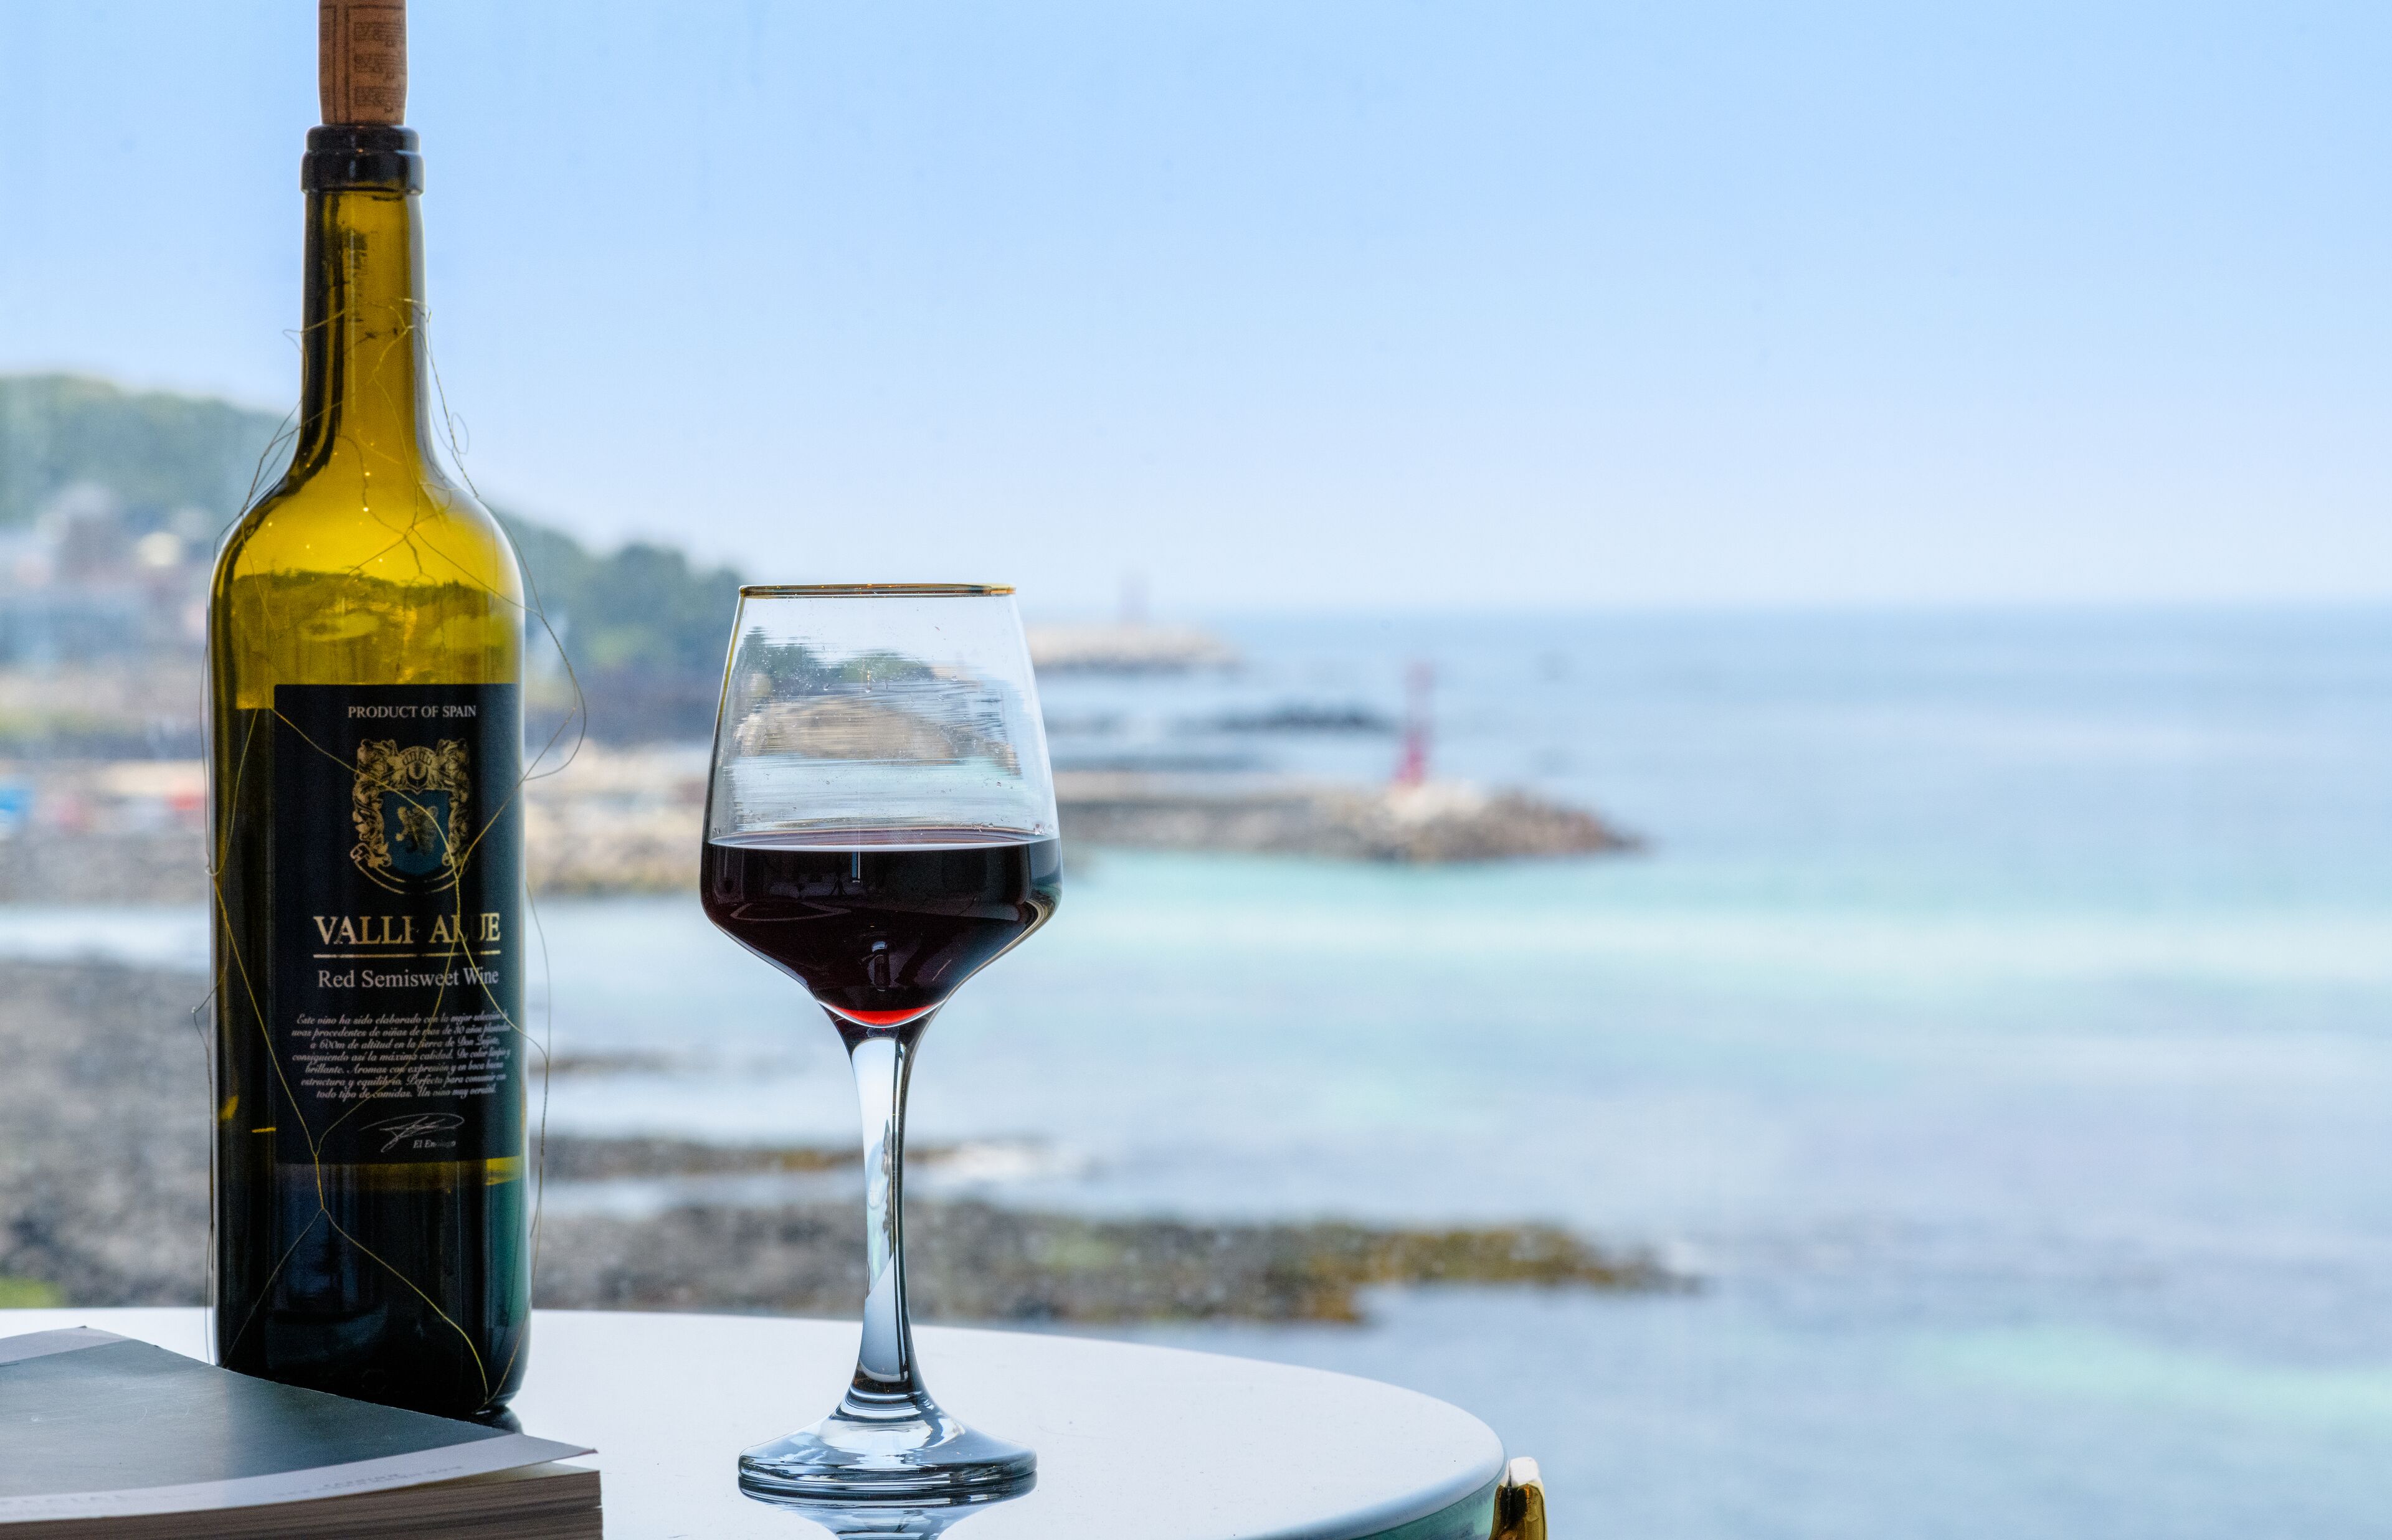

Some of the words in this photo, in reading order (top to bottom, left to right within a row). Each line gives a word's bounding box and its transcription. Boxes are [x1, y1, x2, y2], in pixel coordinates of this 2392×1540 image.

[348, 706, 418, 718] PRODUCT
[421, 706, 439, 717] OF
[442, 705, 477, 717] SPAIN
[318, 970, 355, 988] Red
[361, 969, 459, 988] Semisweet
[463, 966, 498, 985] Wine
[339, 1014, 351, 1024] ha
[353, 1014, 373, 1024] sido
[375, 1013, 422, 1024] elaborado
[311, 1026, 368, 1041] procedentes
[369, 1026, 381, 1036] de
[409, 1026, 420, 1036] de
[442, 1024, 452, 1034] de
[319, 1038, 345, 1049] 600m
[347, 1039, 359, 1049] de
[361, 1039, 394, 1049] altitud
[406, 1037, 416, 1048] la
[445, 1036, 455, 1047] de
[367, 1051, 377, 1061] la
[316, 1087, 336, 1098] todo
[358, 1087, 371, 1098] de
[413, 1139, 423, 1149] El
